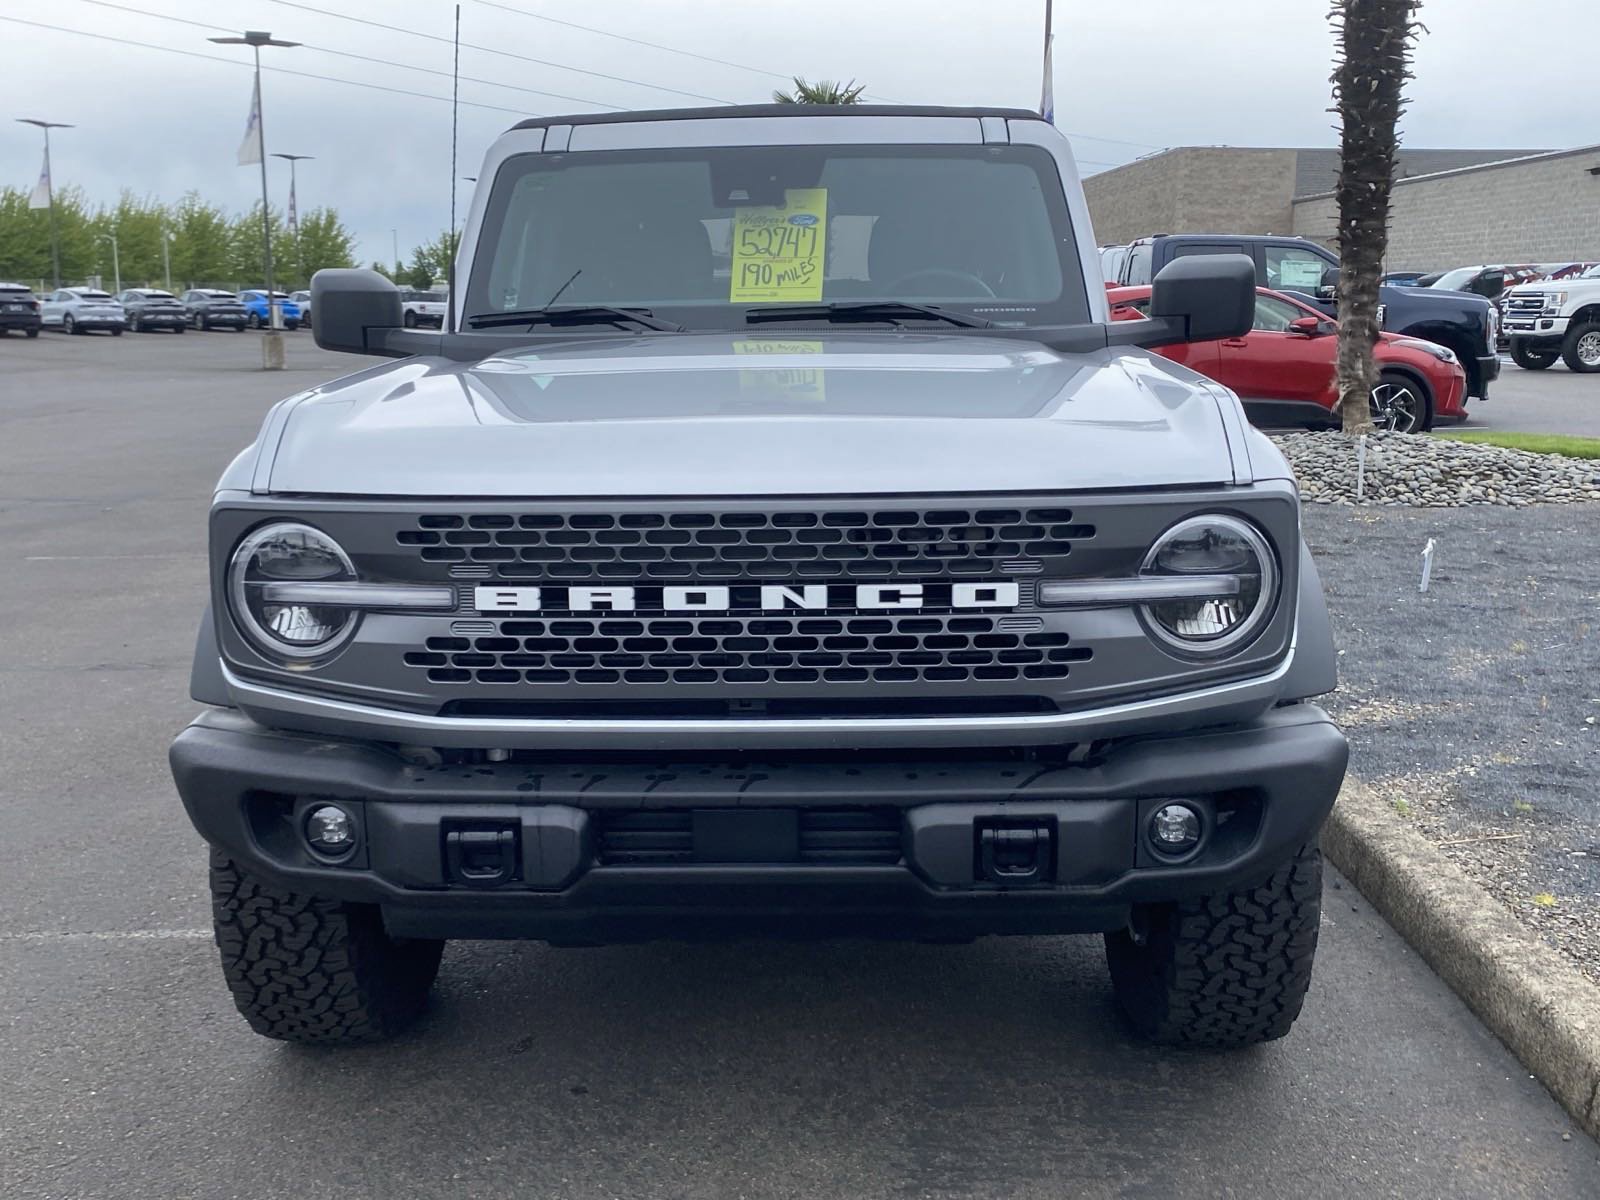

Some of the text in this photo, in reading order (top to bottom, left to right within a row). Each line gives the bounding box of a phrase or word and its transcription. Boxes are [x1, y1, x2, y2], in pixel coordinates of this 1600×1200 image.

[741, 257, 816, 287] 190 MILES
[474, 583, 1019, 611] BRONCO
